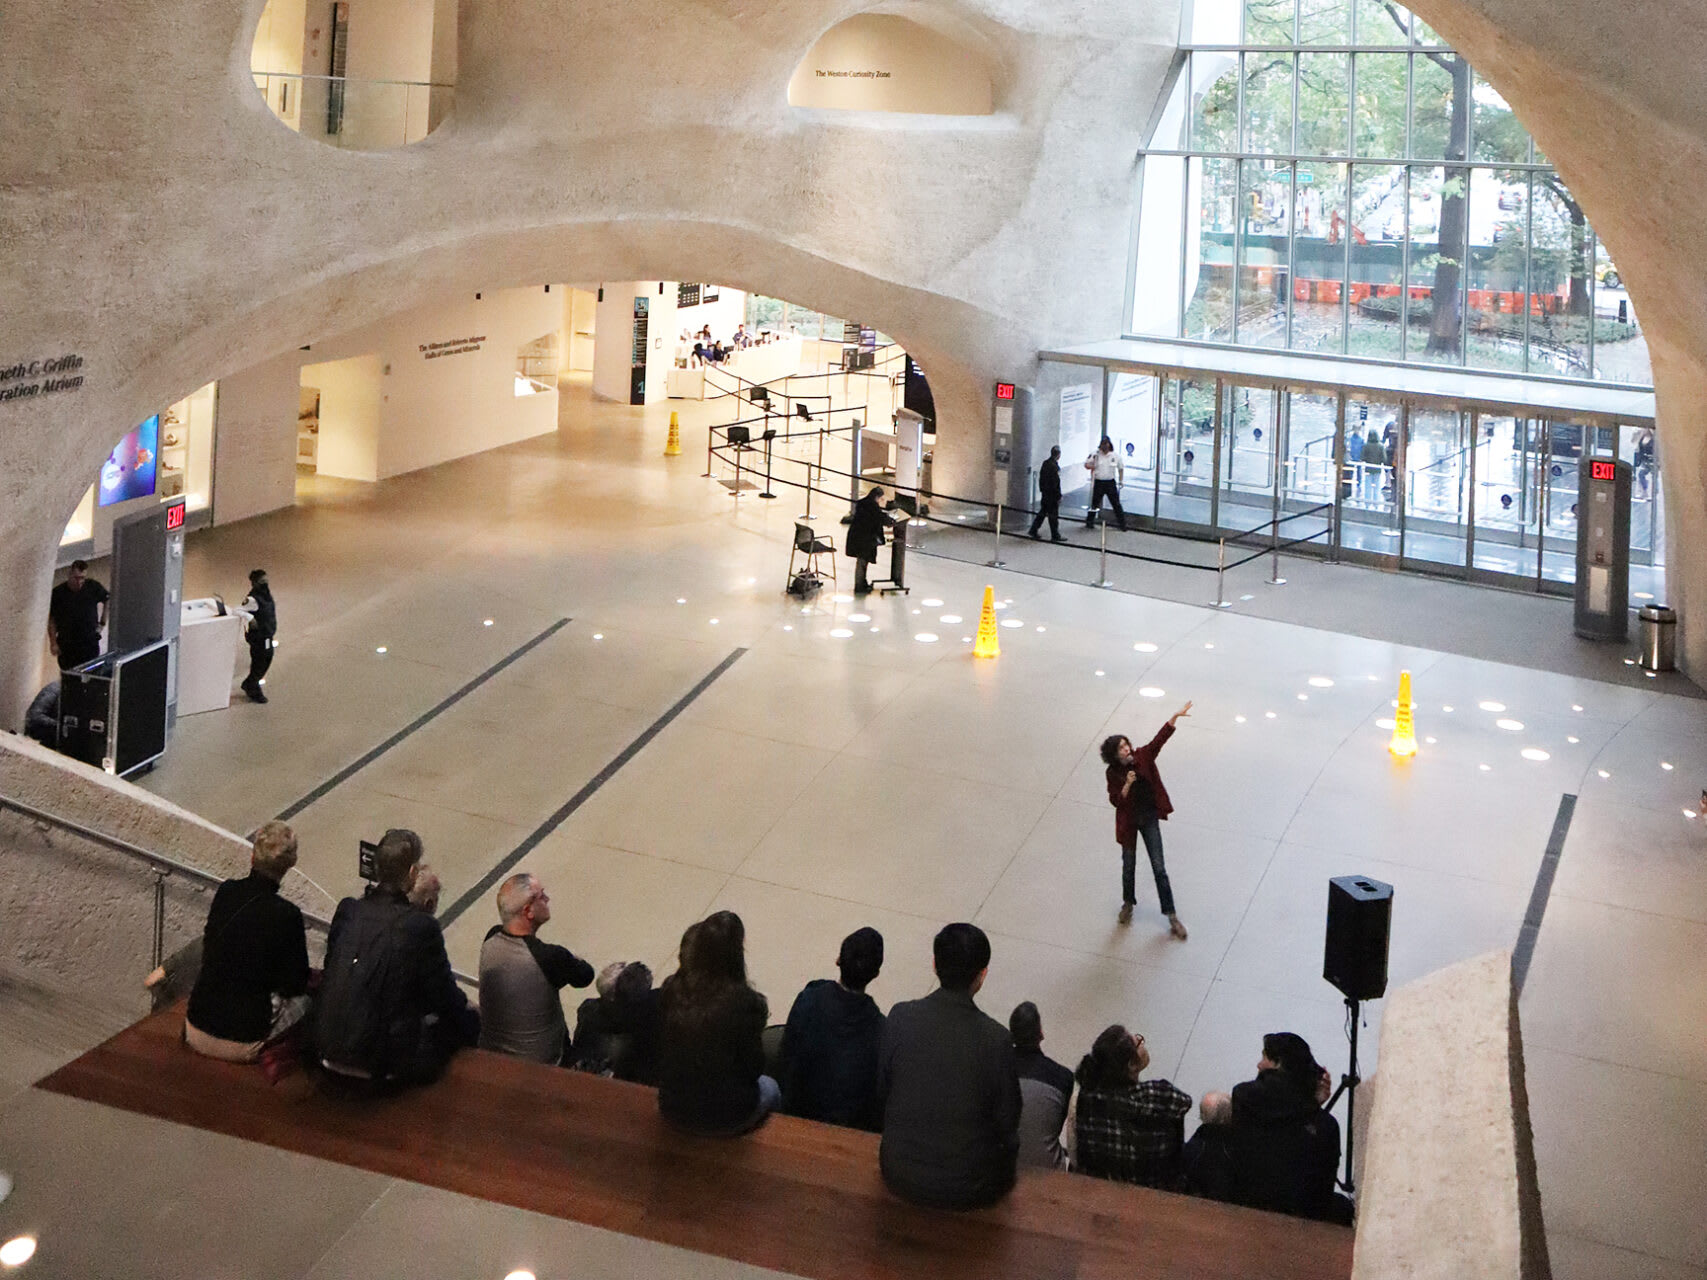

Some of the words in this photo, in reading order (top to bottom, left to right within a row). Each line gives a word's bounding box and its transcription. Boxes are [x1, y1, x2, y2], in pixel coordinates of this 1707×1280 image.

[815, 69, 826, 77] The
[849, 70, 875, 79] Curiosity
[876, 70, 891, 78] Zone
[43, 354, 83, 373] Griffin
[41, 375, 83, 394] Atrium
[997, 384, 1014, 399] EXIT
[1592, 462, 1615, 480] EXIT
[167, 504, 185, 529] EXIT
